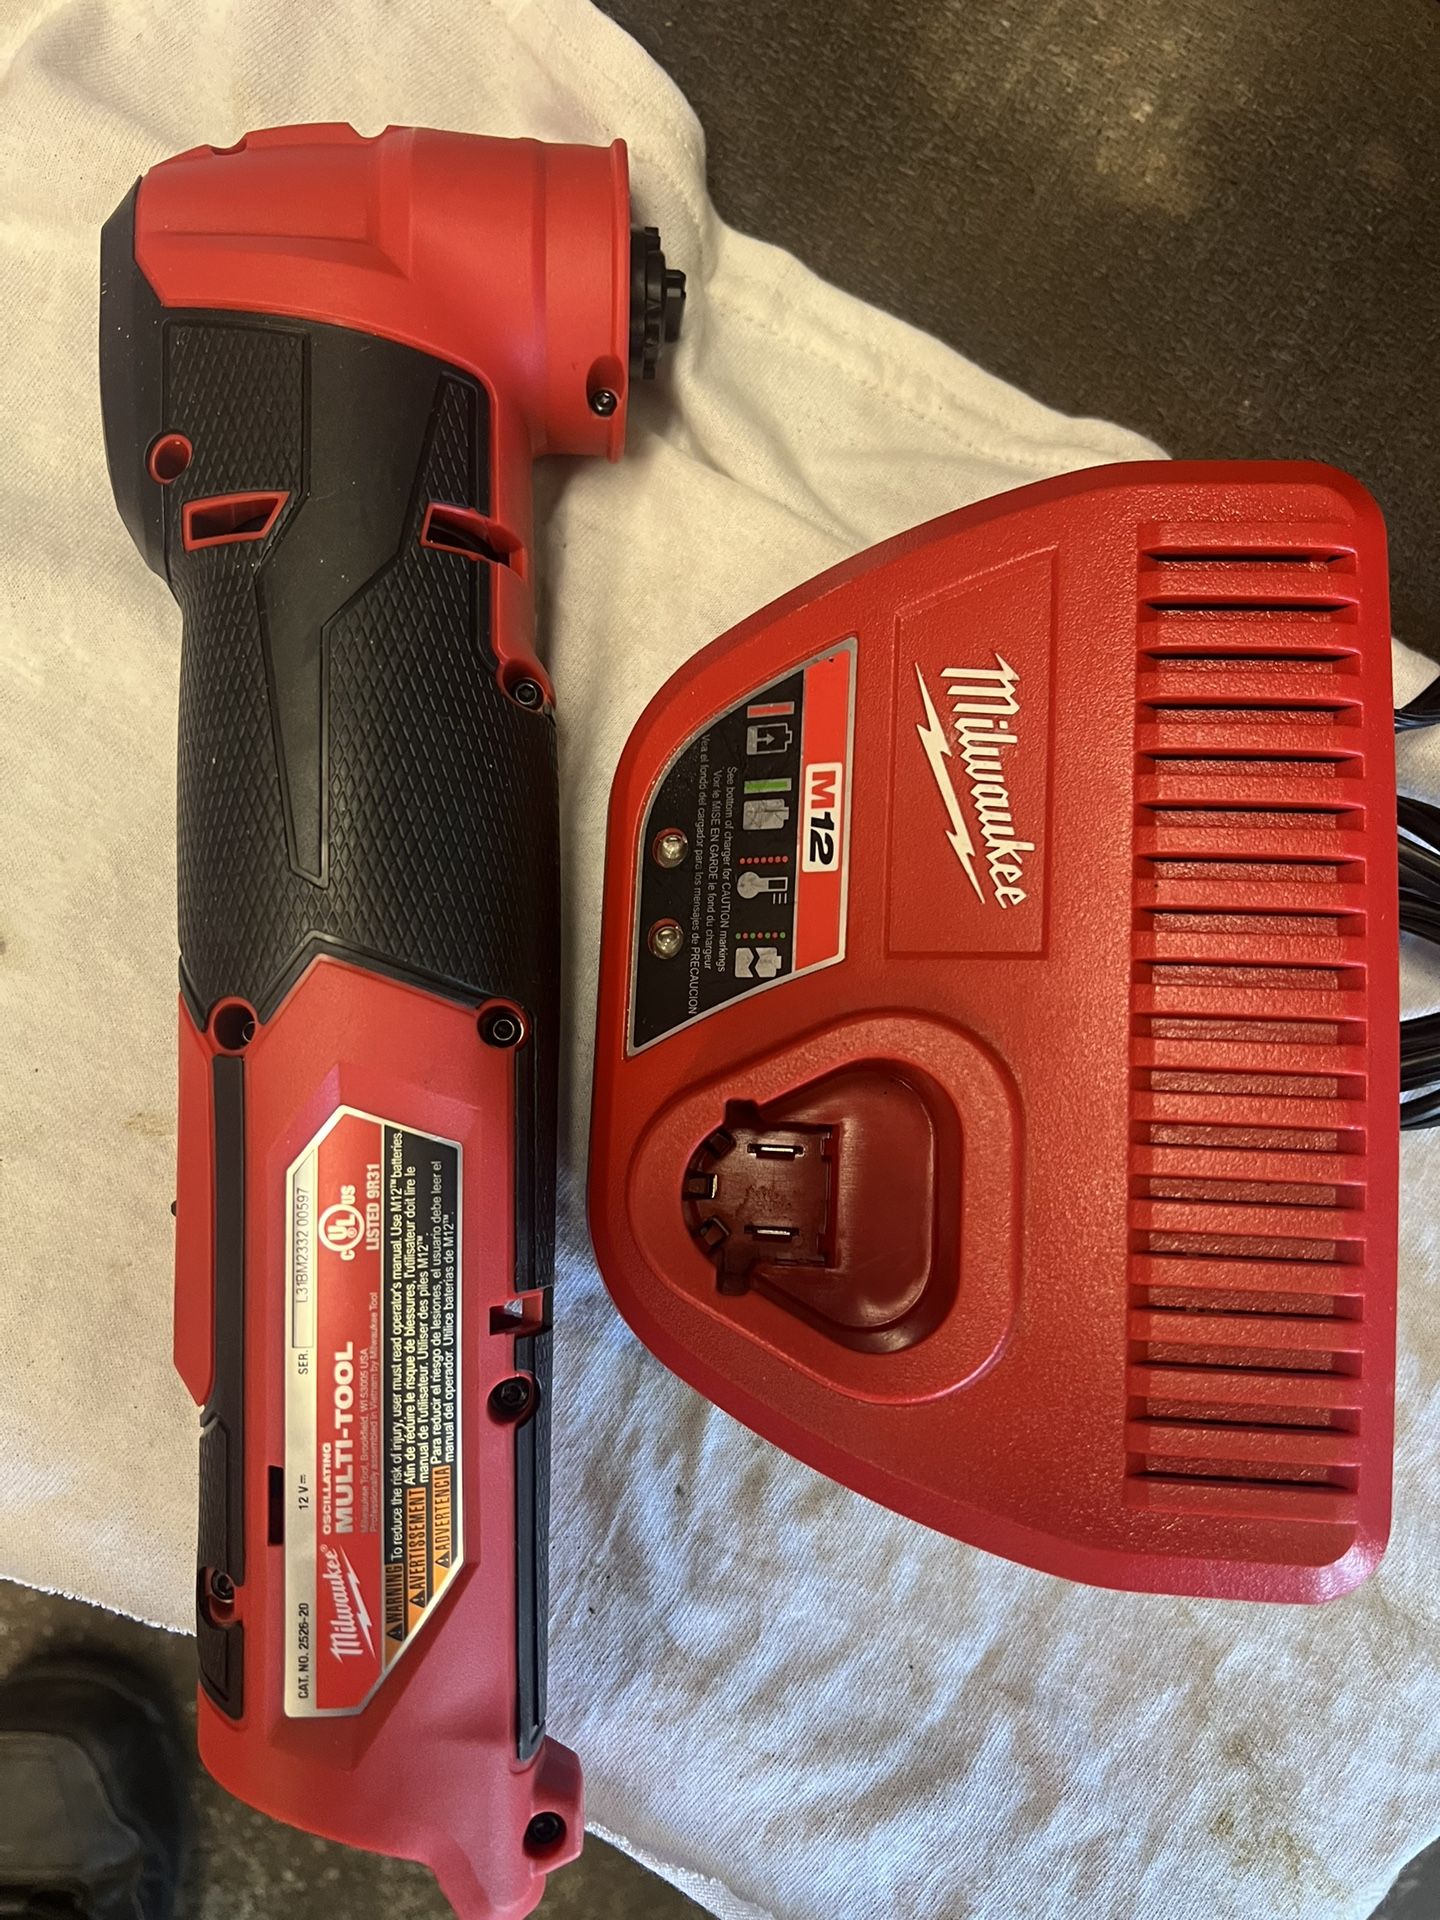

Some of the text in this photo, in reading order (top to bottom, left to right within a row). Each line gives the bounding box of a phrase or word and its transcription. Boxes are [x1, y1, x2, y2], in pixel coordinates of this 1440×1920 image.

[700, 734, 711, 752] Vea
[700, 754, 710, 763] el
[698, 792, 709, 806] del
[940, 653, 1036, 909] Milwaukee
[694, 808, 708, 848] cargador
[810, 770, 836, 865] M12
[694, 850, 704, 870] para
[694, 872, 704, 885] los
[703, 770, 723, 970] Voir le MISE EN GARDE le fond du chargeur
[716, 766, 738, 972] See bottom of charger for CAUTION markings
[690, 888, 702, 930] mensajes
[691, 932, 702, 944] de
[688, 946, 700, 1014] PRECAUCION
[296, 1188, 309, 1226] 00597
[366, 1163, 380, 1250] LISTED 9R31
[390, 1214, 402, 1236] Use
[390, 1238, 402, 1280] manual.
[443, 1250, 454, 1264] de
[370, 1292, 378, 1311] Tool
[418, 1271, 430, 1296] piles
[390, 1282, 404, 1335] operator's
[404, 1166, 418, 1485] Afin de réduire le risque de blessures, l'utilisateur doit lire le
[418, 1299, 429, 1320] des
[430, 1160, 444, 1464] Para reducir el riesgo de lesiones, el usuario debe leer el
[370, 1312, 378, 1359] Milwaukee
[418, 1322, 429, 1360] Utiliser
[443, 1312, 454, 1346] Utilice
[298, 1350, 308, 1375] SER.
[360, 1348, 368, 1369] USA
[390, 1337, 402, 1361] read
[370, 1373, 378, 1410] Vietnam
[391, 1364, 402, 1390] must
[443, 1348, 456, 1400] operador.
[392, 1394, 402, 1416] user
[443, 1402, 454, 1420] del
[334, 1342, 354, 1533] MULTI-TOOL
[370, 1417, 378, 1469] assembled
[390, 1420, 404, 1450] injury,
[418, 1425, 429, 1440] de
[443, 1422, 454, 1462] manual
[390, 1454, 402, 1464] of
[390, 1466, 402, 1485] risk
[418, 1442, 429, 1483] manual
[298, 1497, 308, 1510] 12
[322, 1442, 332, 1535] OSCILLATING
[369, 1472, 380, 1532] Professionally
[390, 1488, 402, 1504] the
[391, 1508, 402, 1544] reduce
[433, 1467, 450, 1551] ADVERTENCIA
[390, 1548, 402, 1561] To
[408, 1490, 425, 1590] AVERTISSEMENT
[385, 1566, 402, 1624] WARNING
[298, 1603, 309, 1699] CAT. NO. 2526-20
